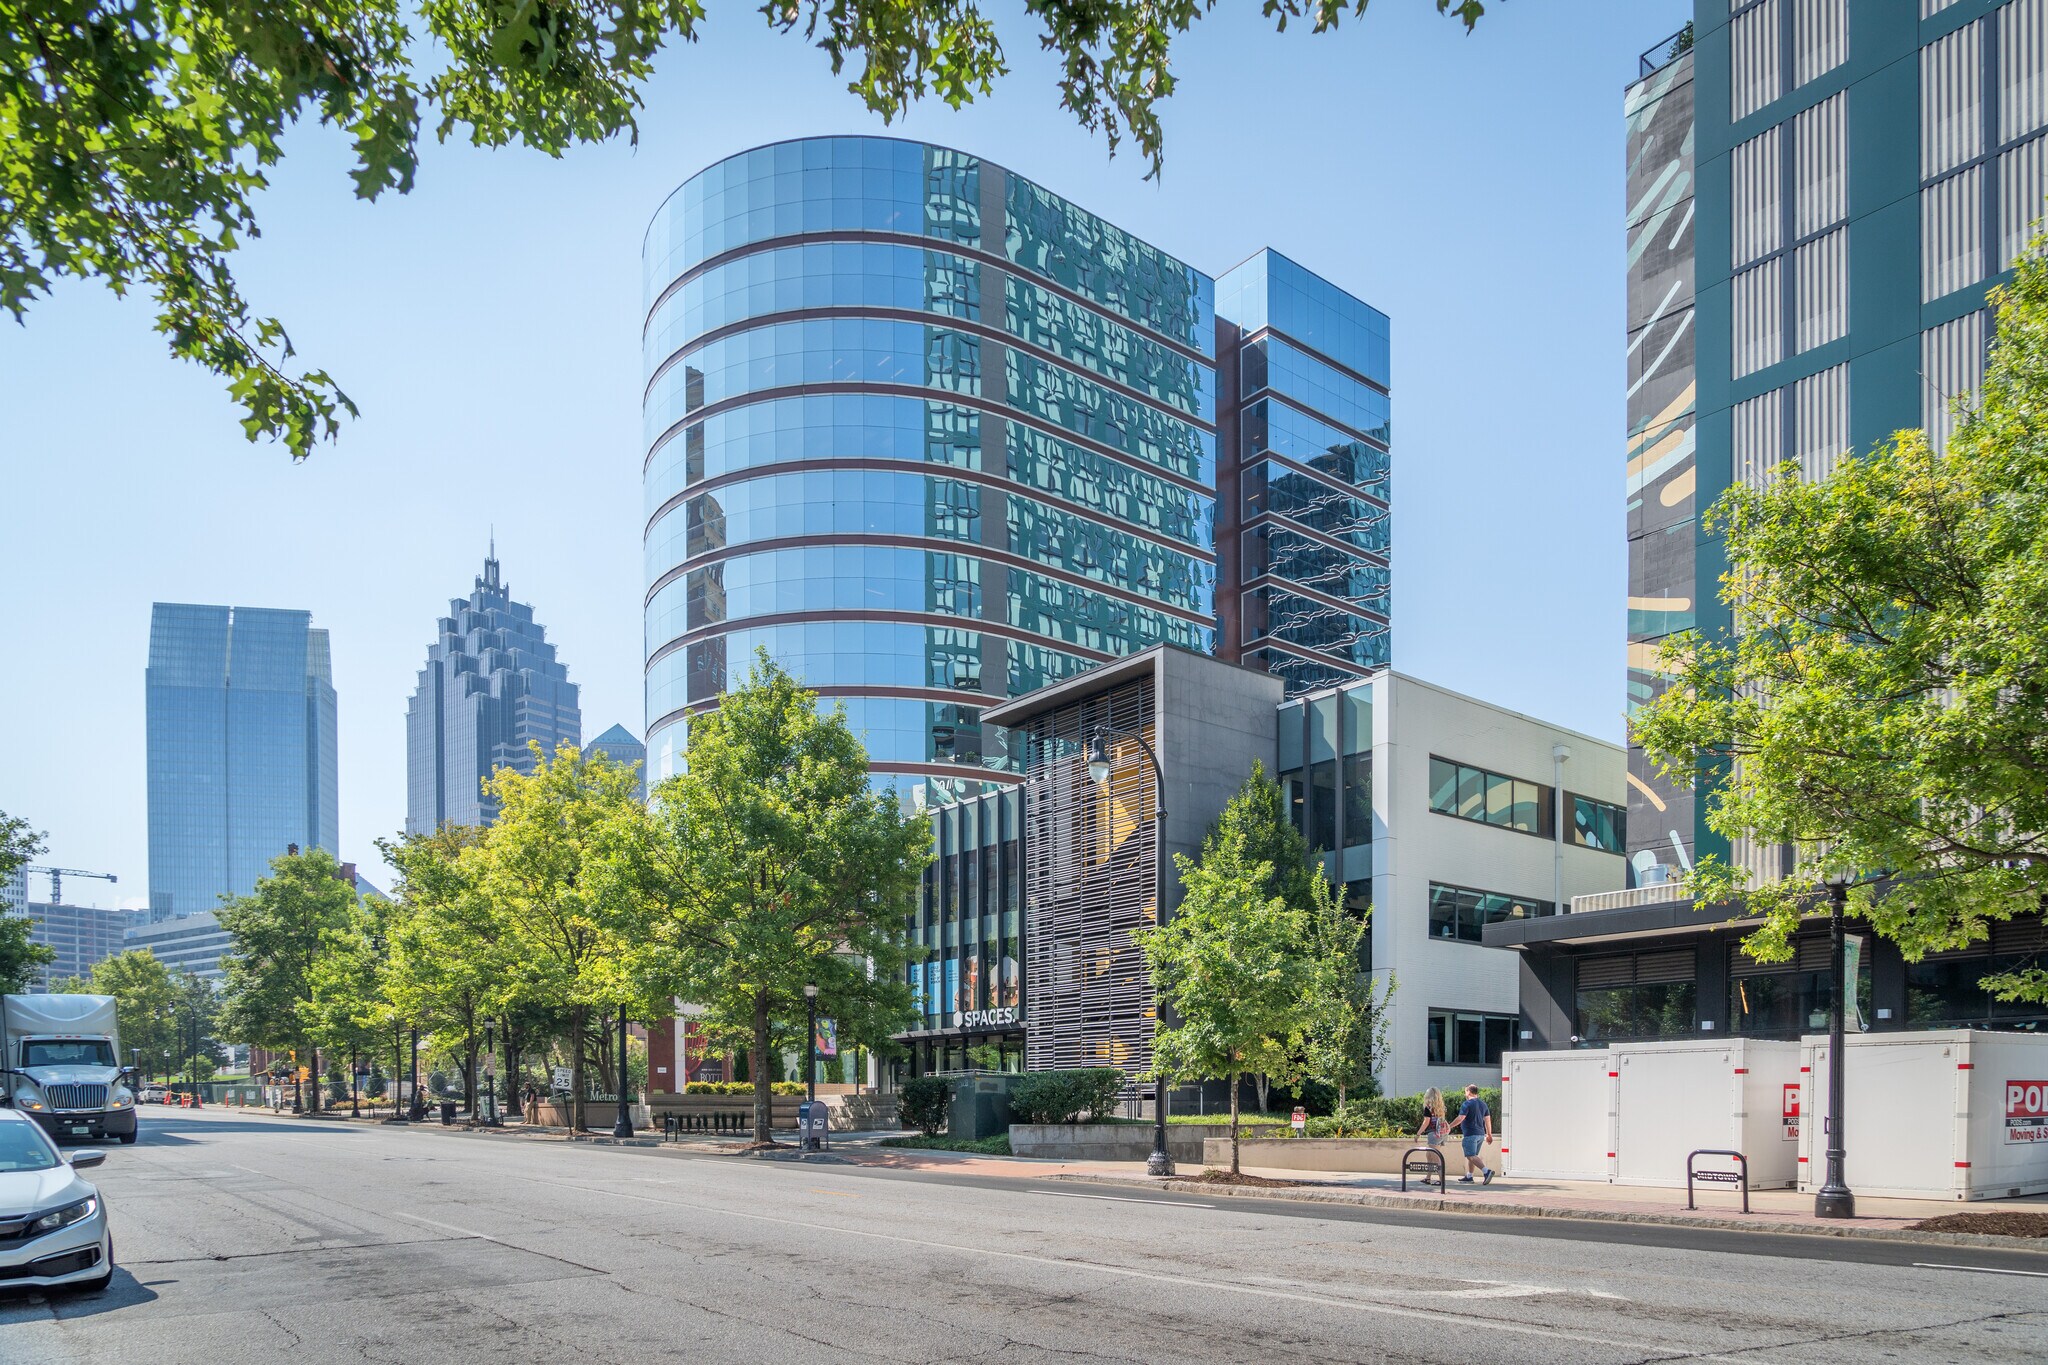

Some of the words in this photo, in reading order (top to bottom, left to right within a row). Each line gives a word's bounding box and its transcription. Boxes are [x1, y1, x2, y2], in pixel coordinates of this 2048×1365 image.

[964, 1006, 1016, 1028] SPACES.
[556, 1078, 570, 1087] 25
[590, 1090, 618, 1102] Metro
[2010, 1128, 2035, 1142] Moving
[2036, 1127, 2042, 1139] &
[1697, 1172, 1738, 1181] MIDTOWN
